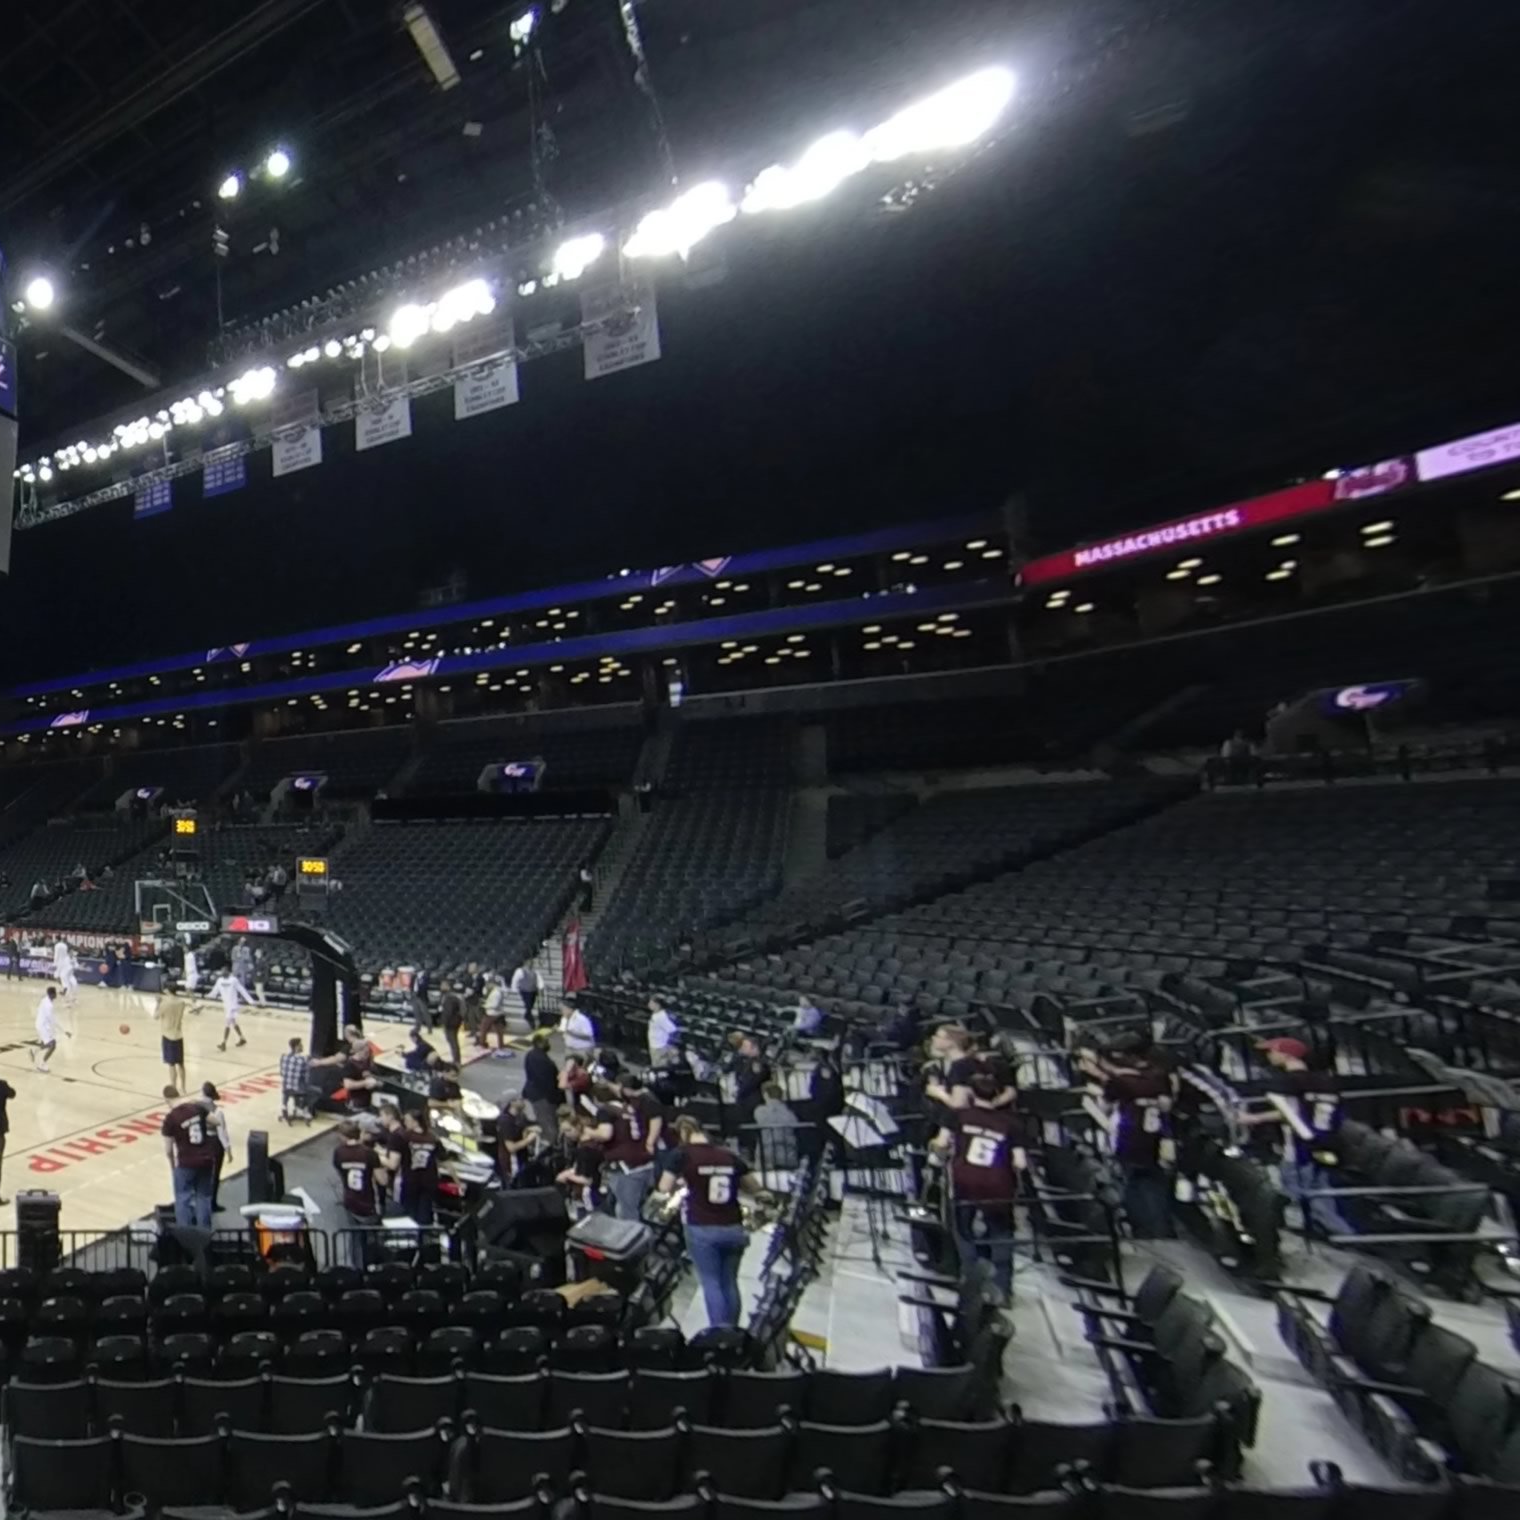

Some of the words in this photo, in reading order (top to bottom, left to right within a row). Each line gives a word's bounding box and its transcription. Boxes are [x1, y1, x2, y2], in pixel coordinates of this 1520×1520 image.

[1073, 509, 1241, 568] MASSACHUSETTS
[229, 915, 271, 932] A10
[965, 1136, 998, 1167] 6
[347, 1168, 363, 1192] 6
[708, 1175, 731, 1204] 6
